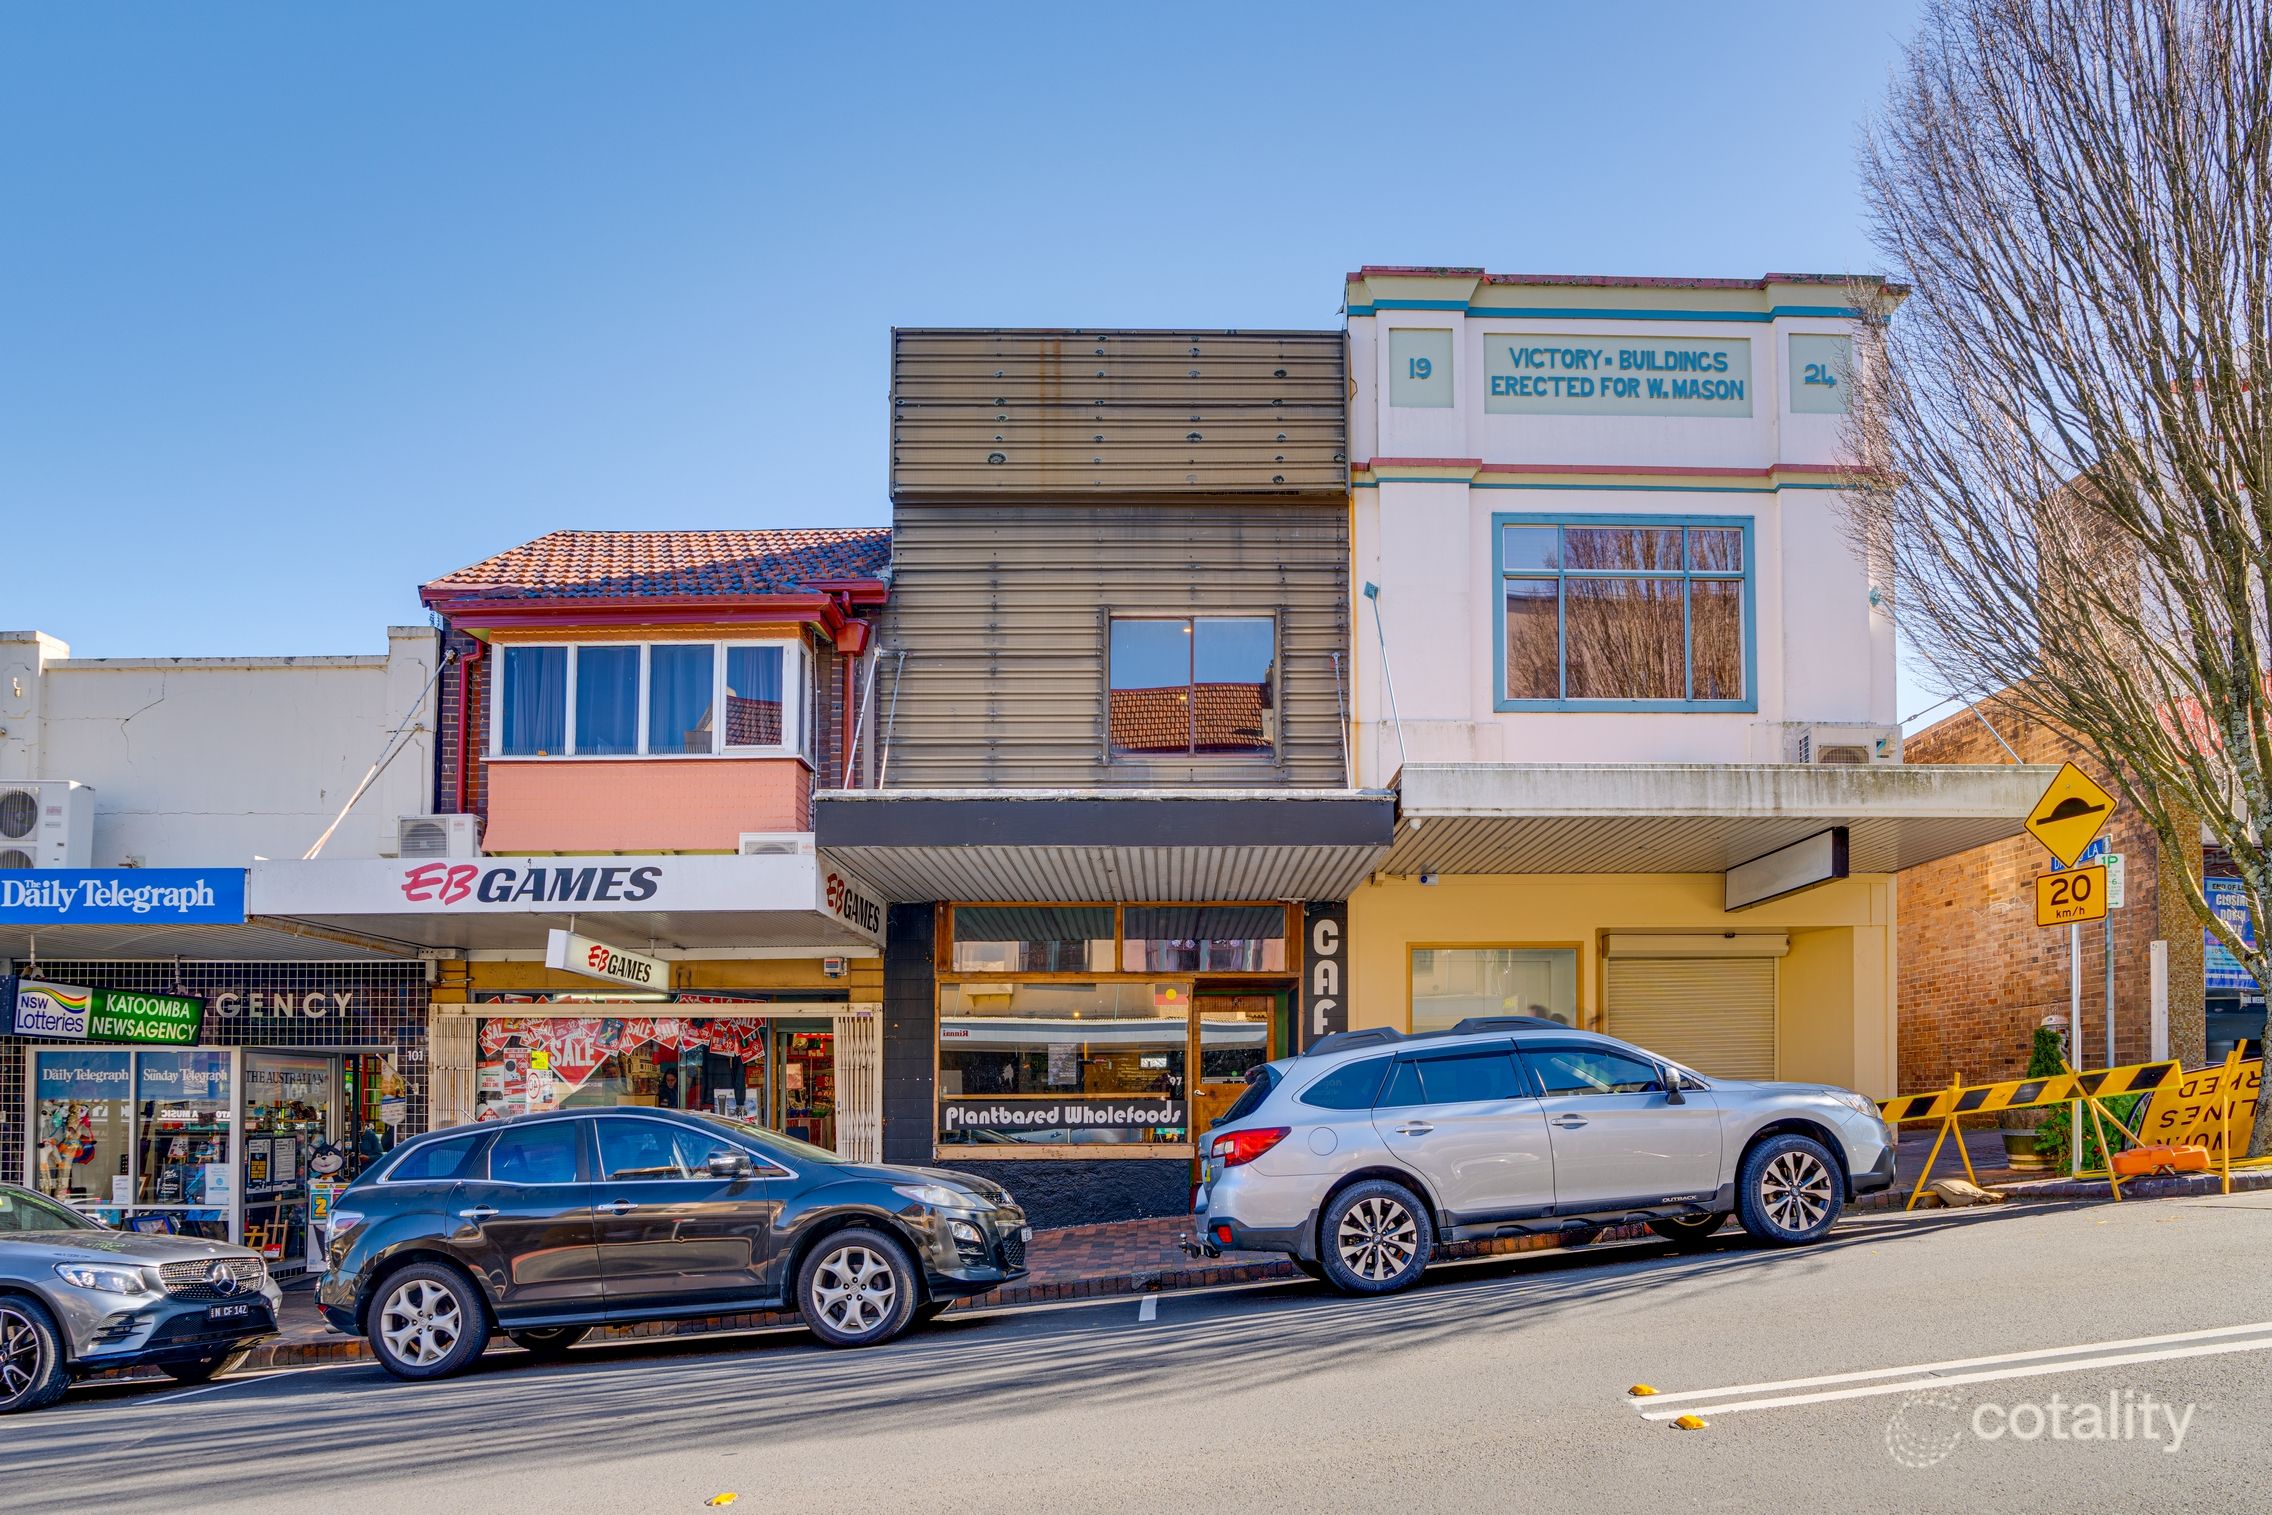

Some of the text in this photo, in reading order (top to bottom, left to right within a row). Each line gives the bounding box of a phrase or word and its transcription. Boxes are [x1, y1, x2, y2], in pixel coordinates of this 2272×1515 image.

[1409, 357, 1432, 380] 19
[1509, 347, 1729, 373] VICTORY BUILDINGS
[1491, 376, 1595, 398] ERECTED
[1600, 377, 1641, 399] FOR
[1804, 363, 1836, 388] 24
[1, 879, 215, 913] The Daily Telegraph
[401, 862, 663, 906] EB GAMES
[2050, 874, 2091, 906] 20
[826, 873, 880, 934] EB GAMES
[2056, 906, 2085, 918] km/h
[588, 945, 652, 983] EB GAMES
[1313, 919, 1339, 1036] CAF
[20, 996, 50, 1010] NSW
[106, 993, 190, 1018] KATOOMBA
[16, 1008, 84, 1032] Lotteries
[91, 1016, 197, 1041] NEWSAGENCY
[408, 1050, 424, 1061] 101
[550, 1037, 596, 1067] SALE
[43, 1068, 75, 1083] Daily
[74, 1068, 129, 1082] Telegraph
[143, 1068, 178, 1084] Sunday
[180, 1068, 227, 1084] Telegraph
[246, 1070, 265, 1082] THE
[1169, 1076, 1182, 1086] 97
[945, 1100, 1181, 1130] Plantbased Wholefoods
[2159, 1099, 2258, 1129] LINES
